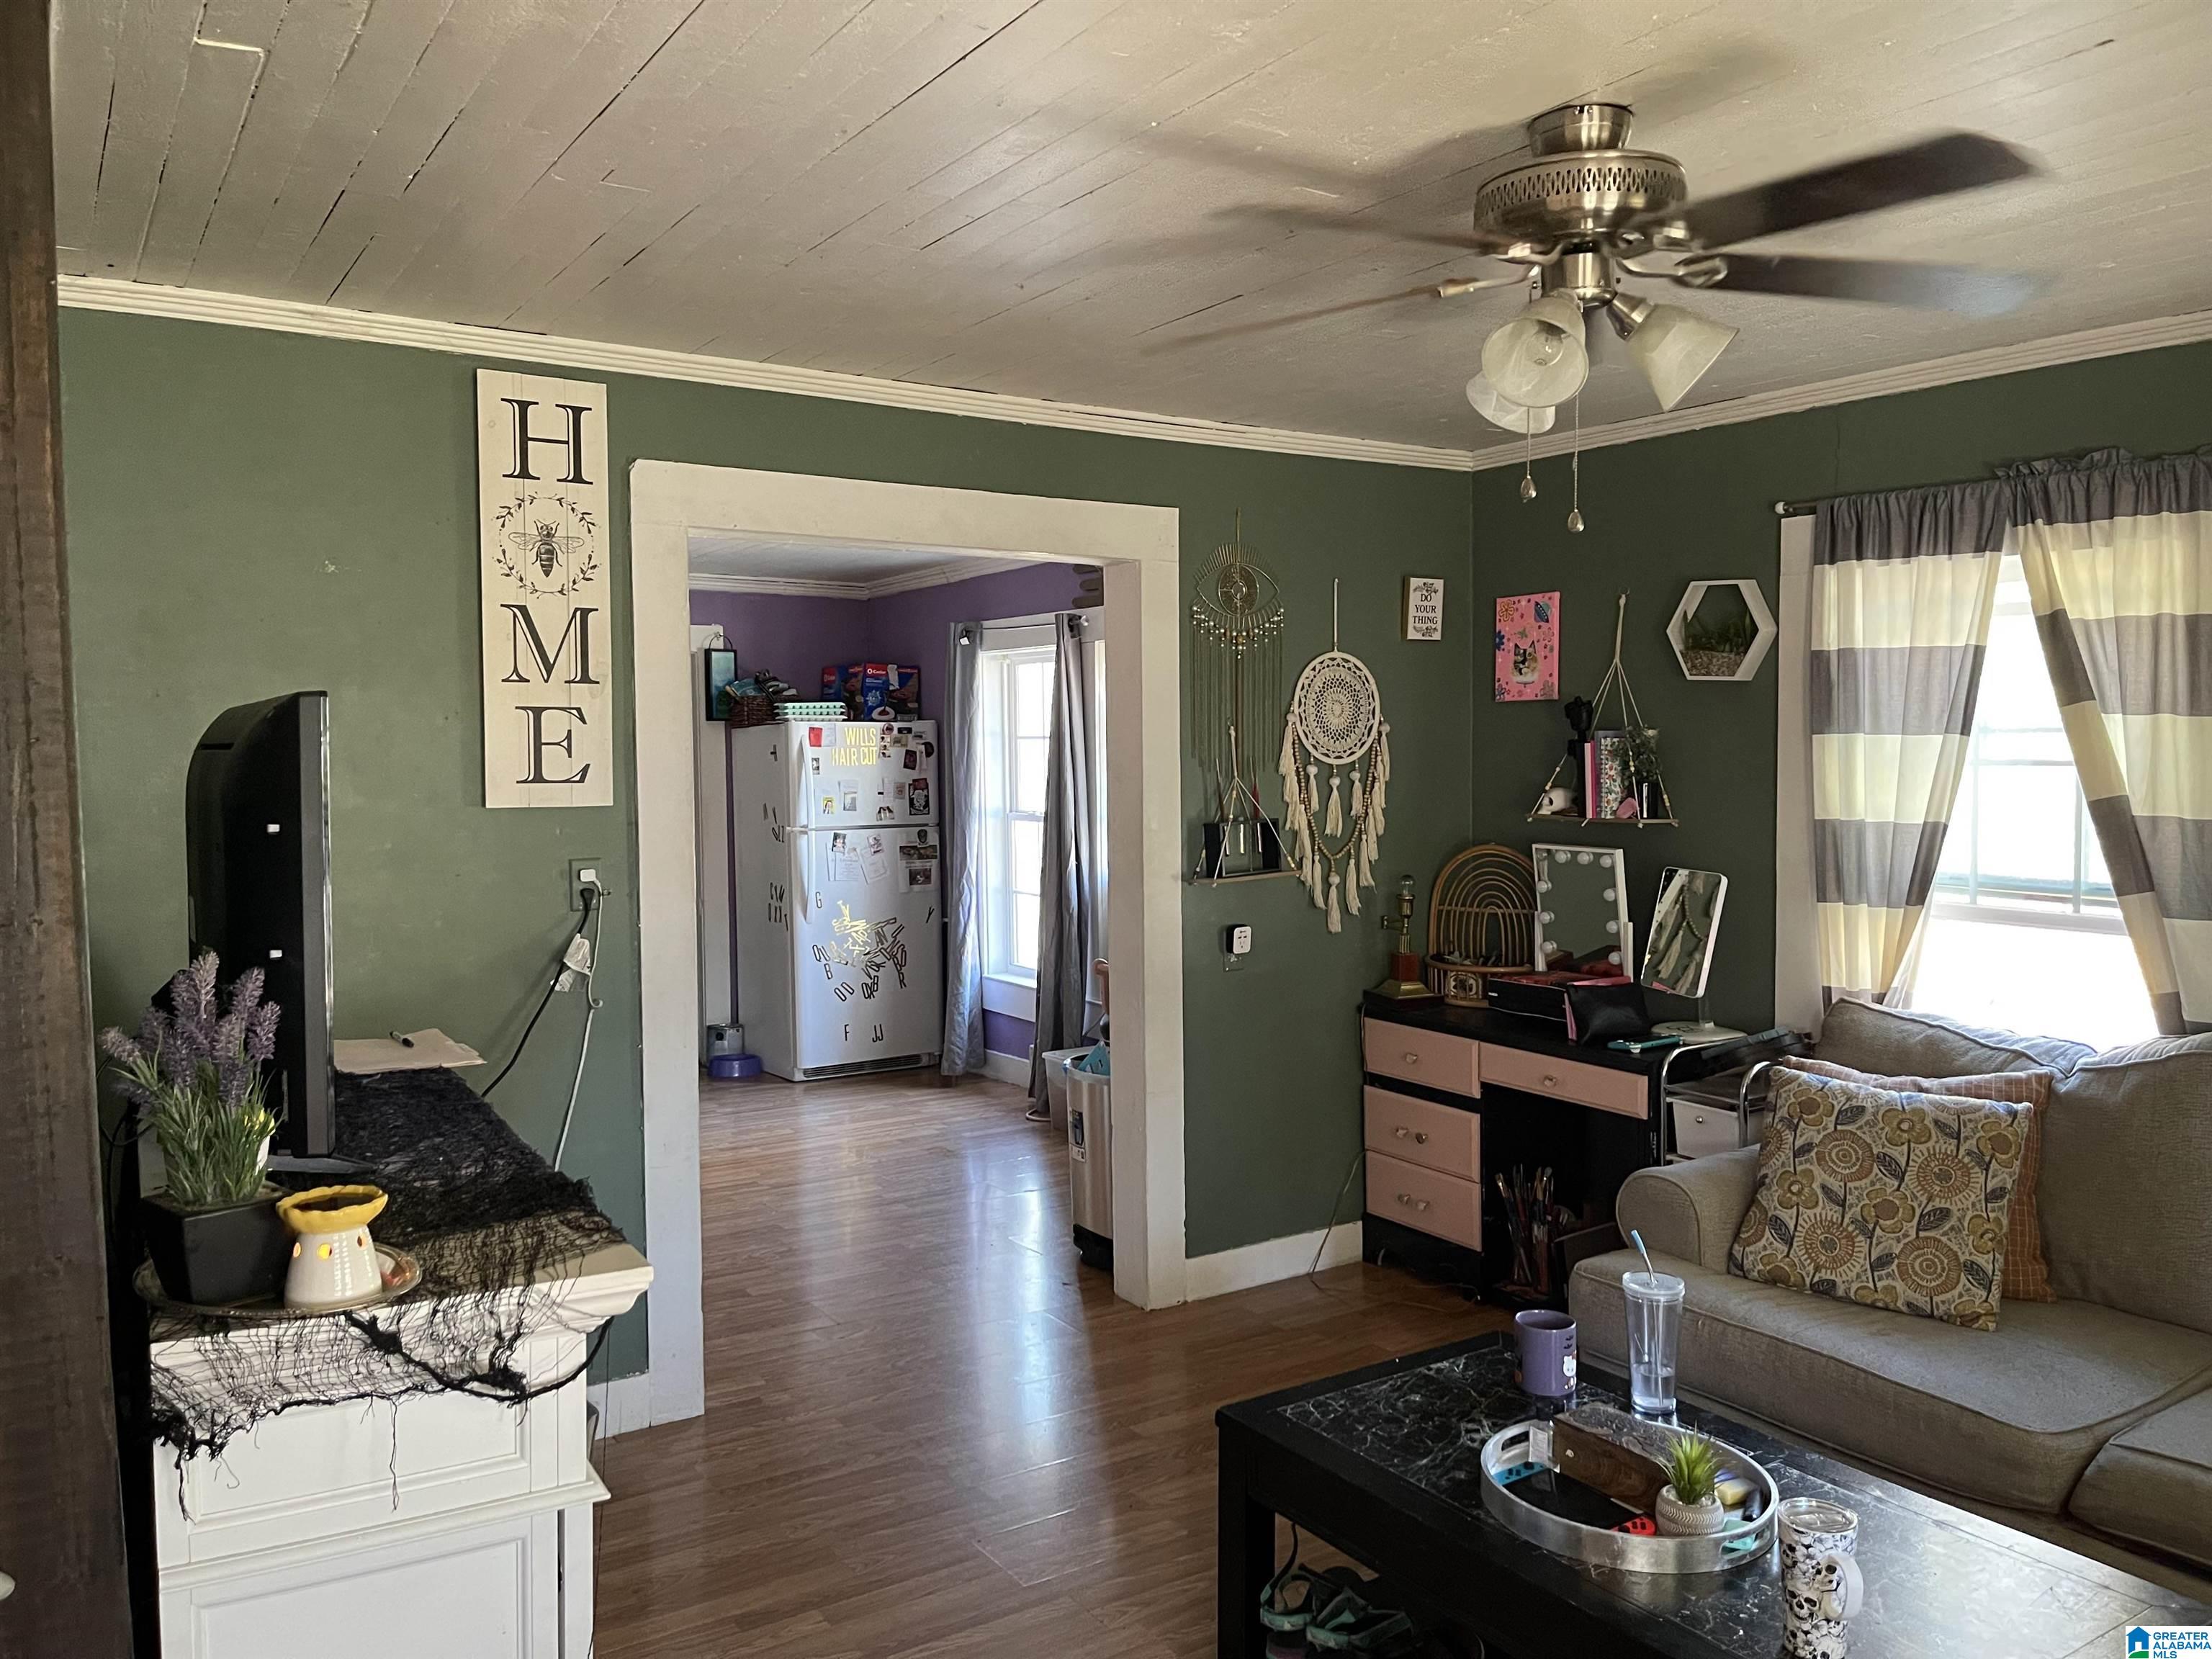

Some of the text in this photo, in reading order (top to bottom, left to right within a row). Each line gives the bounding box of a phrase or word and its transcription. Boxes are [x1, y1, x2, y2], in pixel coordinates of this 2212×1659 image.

[1420, 593, 1432, 602] DO
[1414, 604, 1437, 613] YOUR
[1412, 616, 1438, 625] THING
[845, 727, 876, 746] WILLS
[832, 747, 878, 767] HAIR CUT
[815, 891, 823, 909] G
[844, 1023, 850, 1042] F
